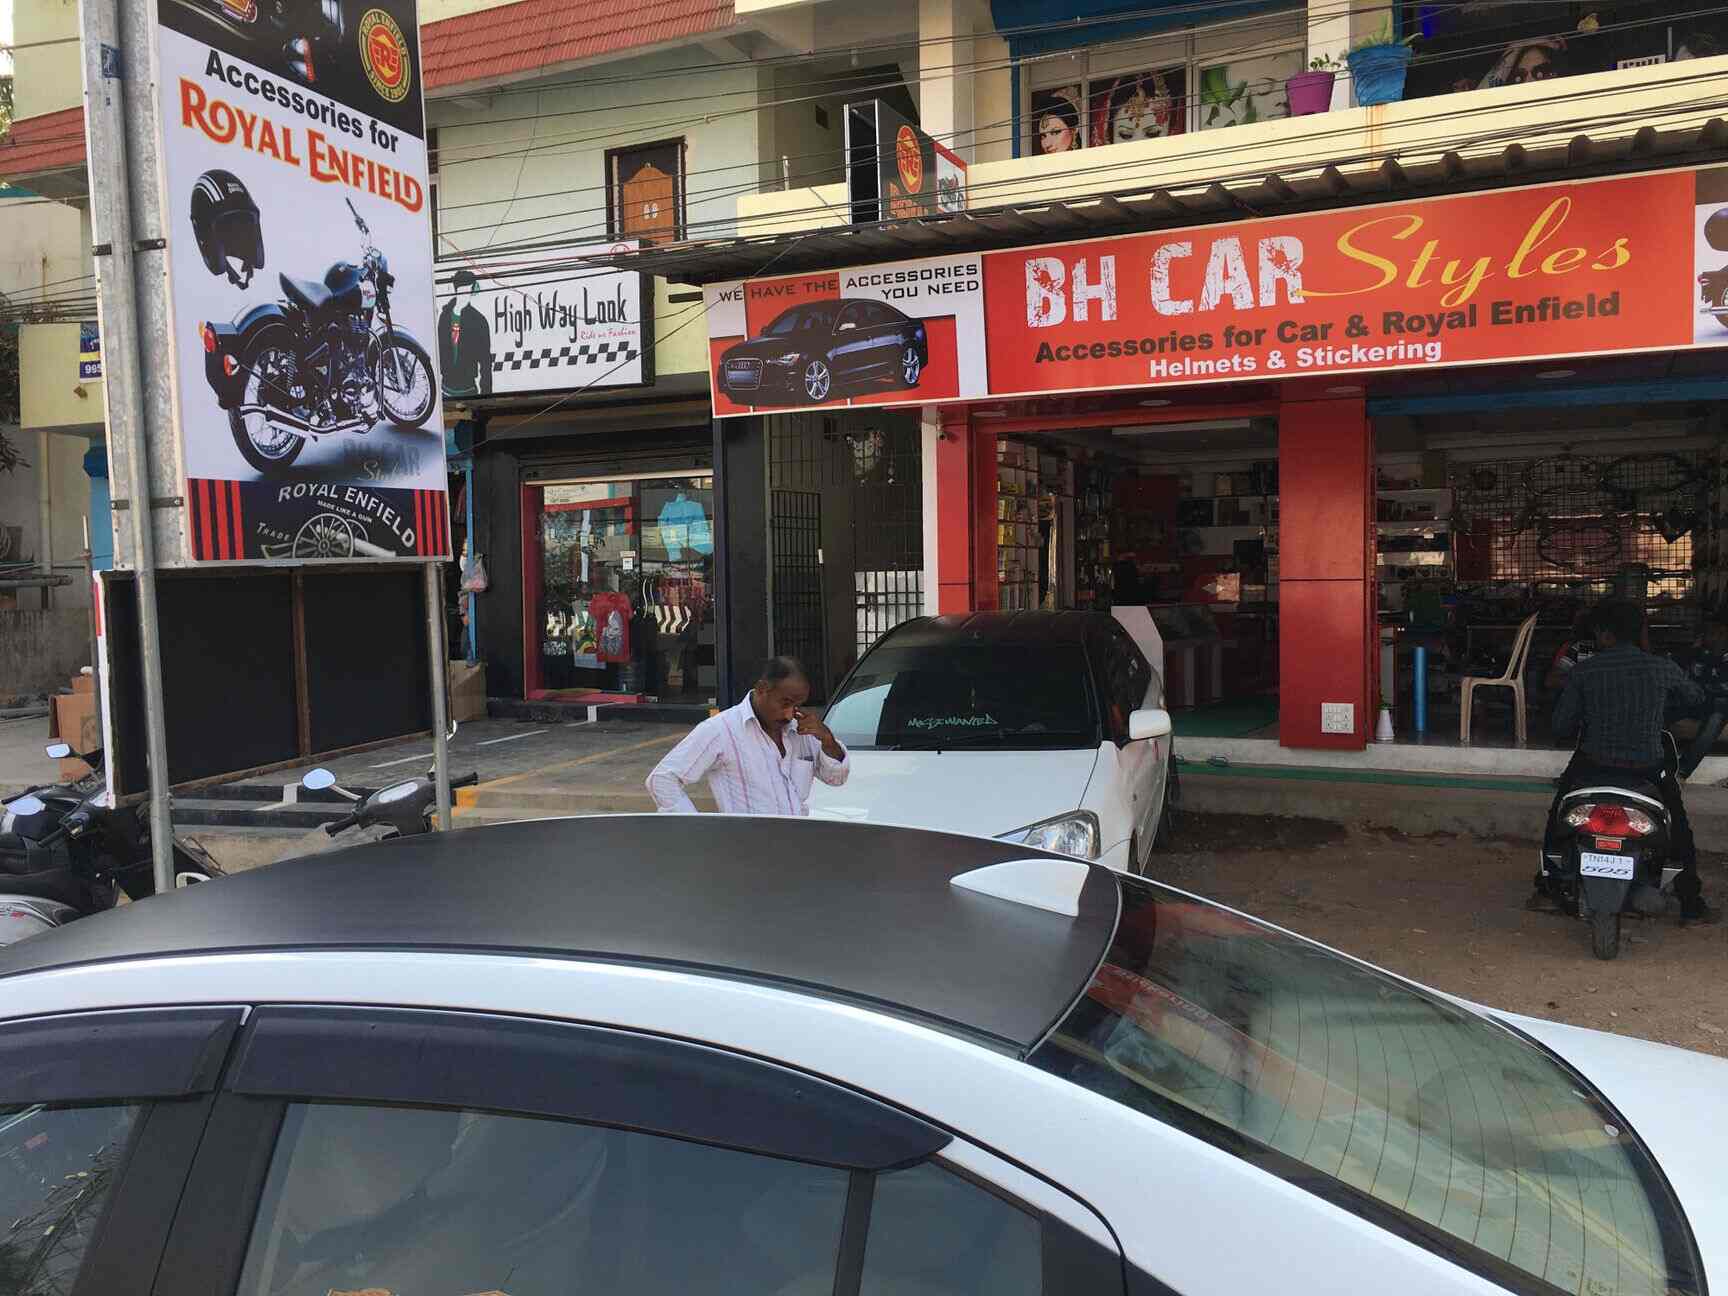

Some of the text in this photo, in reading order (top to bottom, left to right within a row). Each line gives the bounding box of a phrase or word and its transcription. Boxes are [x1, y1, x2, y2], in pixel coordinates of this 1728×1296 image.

[205, 50, 399, 153] Accessories for
[178, 76, 424, 214] ROYAL ENFIELD
[719, 263, 978, 302] WE HAVE THE ACCESSORIES
[882, 279, 979, 300] YOU NEED
[1025, 196, 1631, 328] BH CAR Styles
[493, 282, 627, 348] High Way Look
[1035, 291, 1620, 363] Accessories for Car & Royal Enfield
[1150, 340, 1442, 378] Helmets & Stickering
[257, 522, 290, 541] TRADE
[278, 482, 416, 548] ROYAL ENFIELD
[318, 500, 335, 510] MADE
[336, 506, 351, 516] LIKE
[358, 513, 373, 523] GUN
